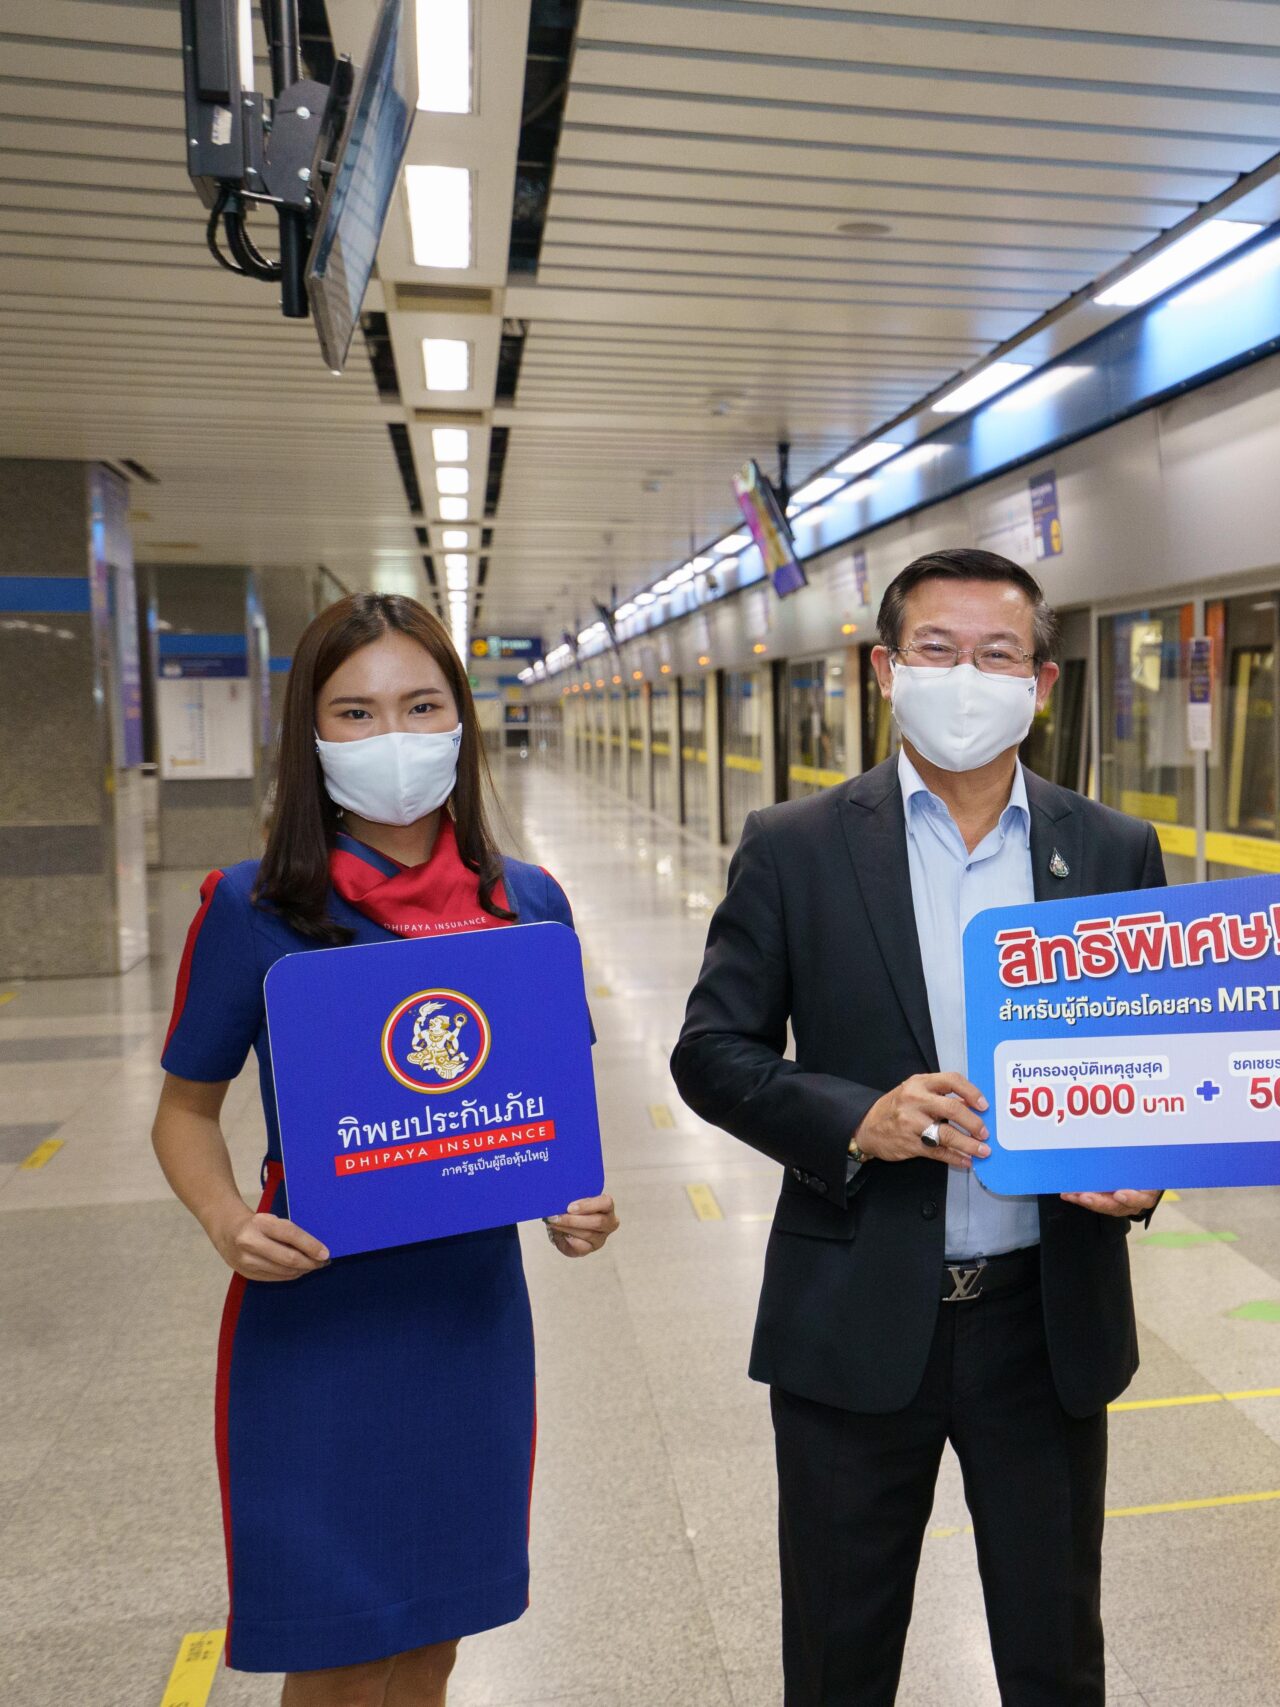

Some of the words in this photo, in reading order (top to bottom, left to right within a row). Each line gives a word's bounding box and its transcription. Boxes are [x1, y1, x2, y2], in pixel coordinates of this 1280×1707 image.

[384, 922, 431, 932] DHIPAYA
[434, 916, 487, 930] INSURANCE
[999, 993, 1212, 1025] สำหรับผู้ถือบัตรโดยสาร
[1012, 1060, 1163, 1083] คุ้มครองอุบัติเหตุสูงสุด
[1009, 1083, 1135, 1124] 50,000
[1142, 1095, 1185, 1114] บาท
[337, 1091, 545, 1149] ทิพยประกันภัย
[345, 1148, 429, 1170] DHIPAYA
[439, 1126, 548, 1154] INSURANCE
[441, 1147, 550, 1177] ภาครัฐเป็นผู้ถือหุ้นใหญ่
